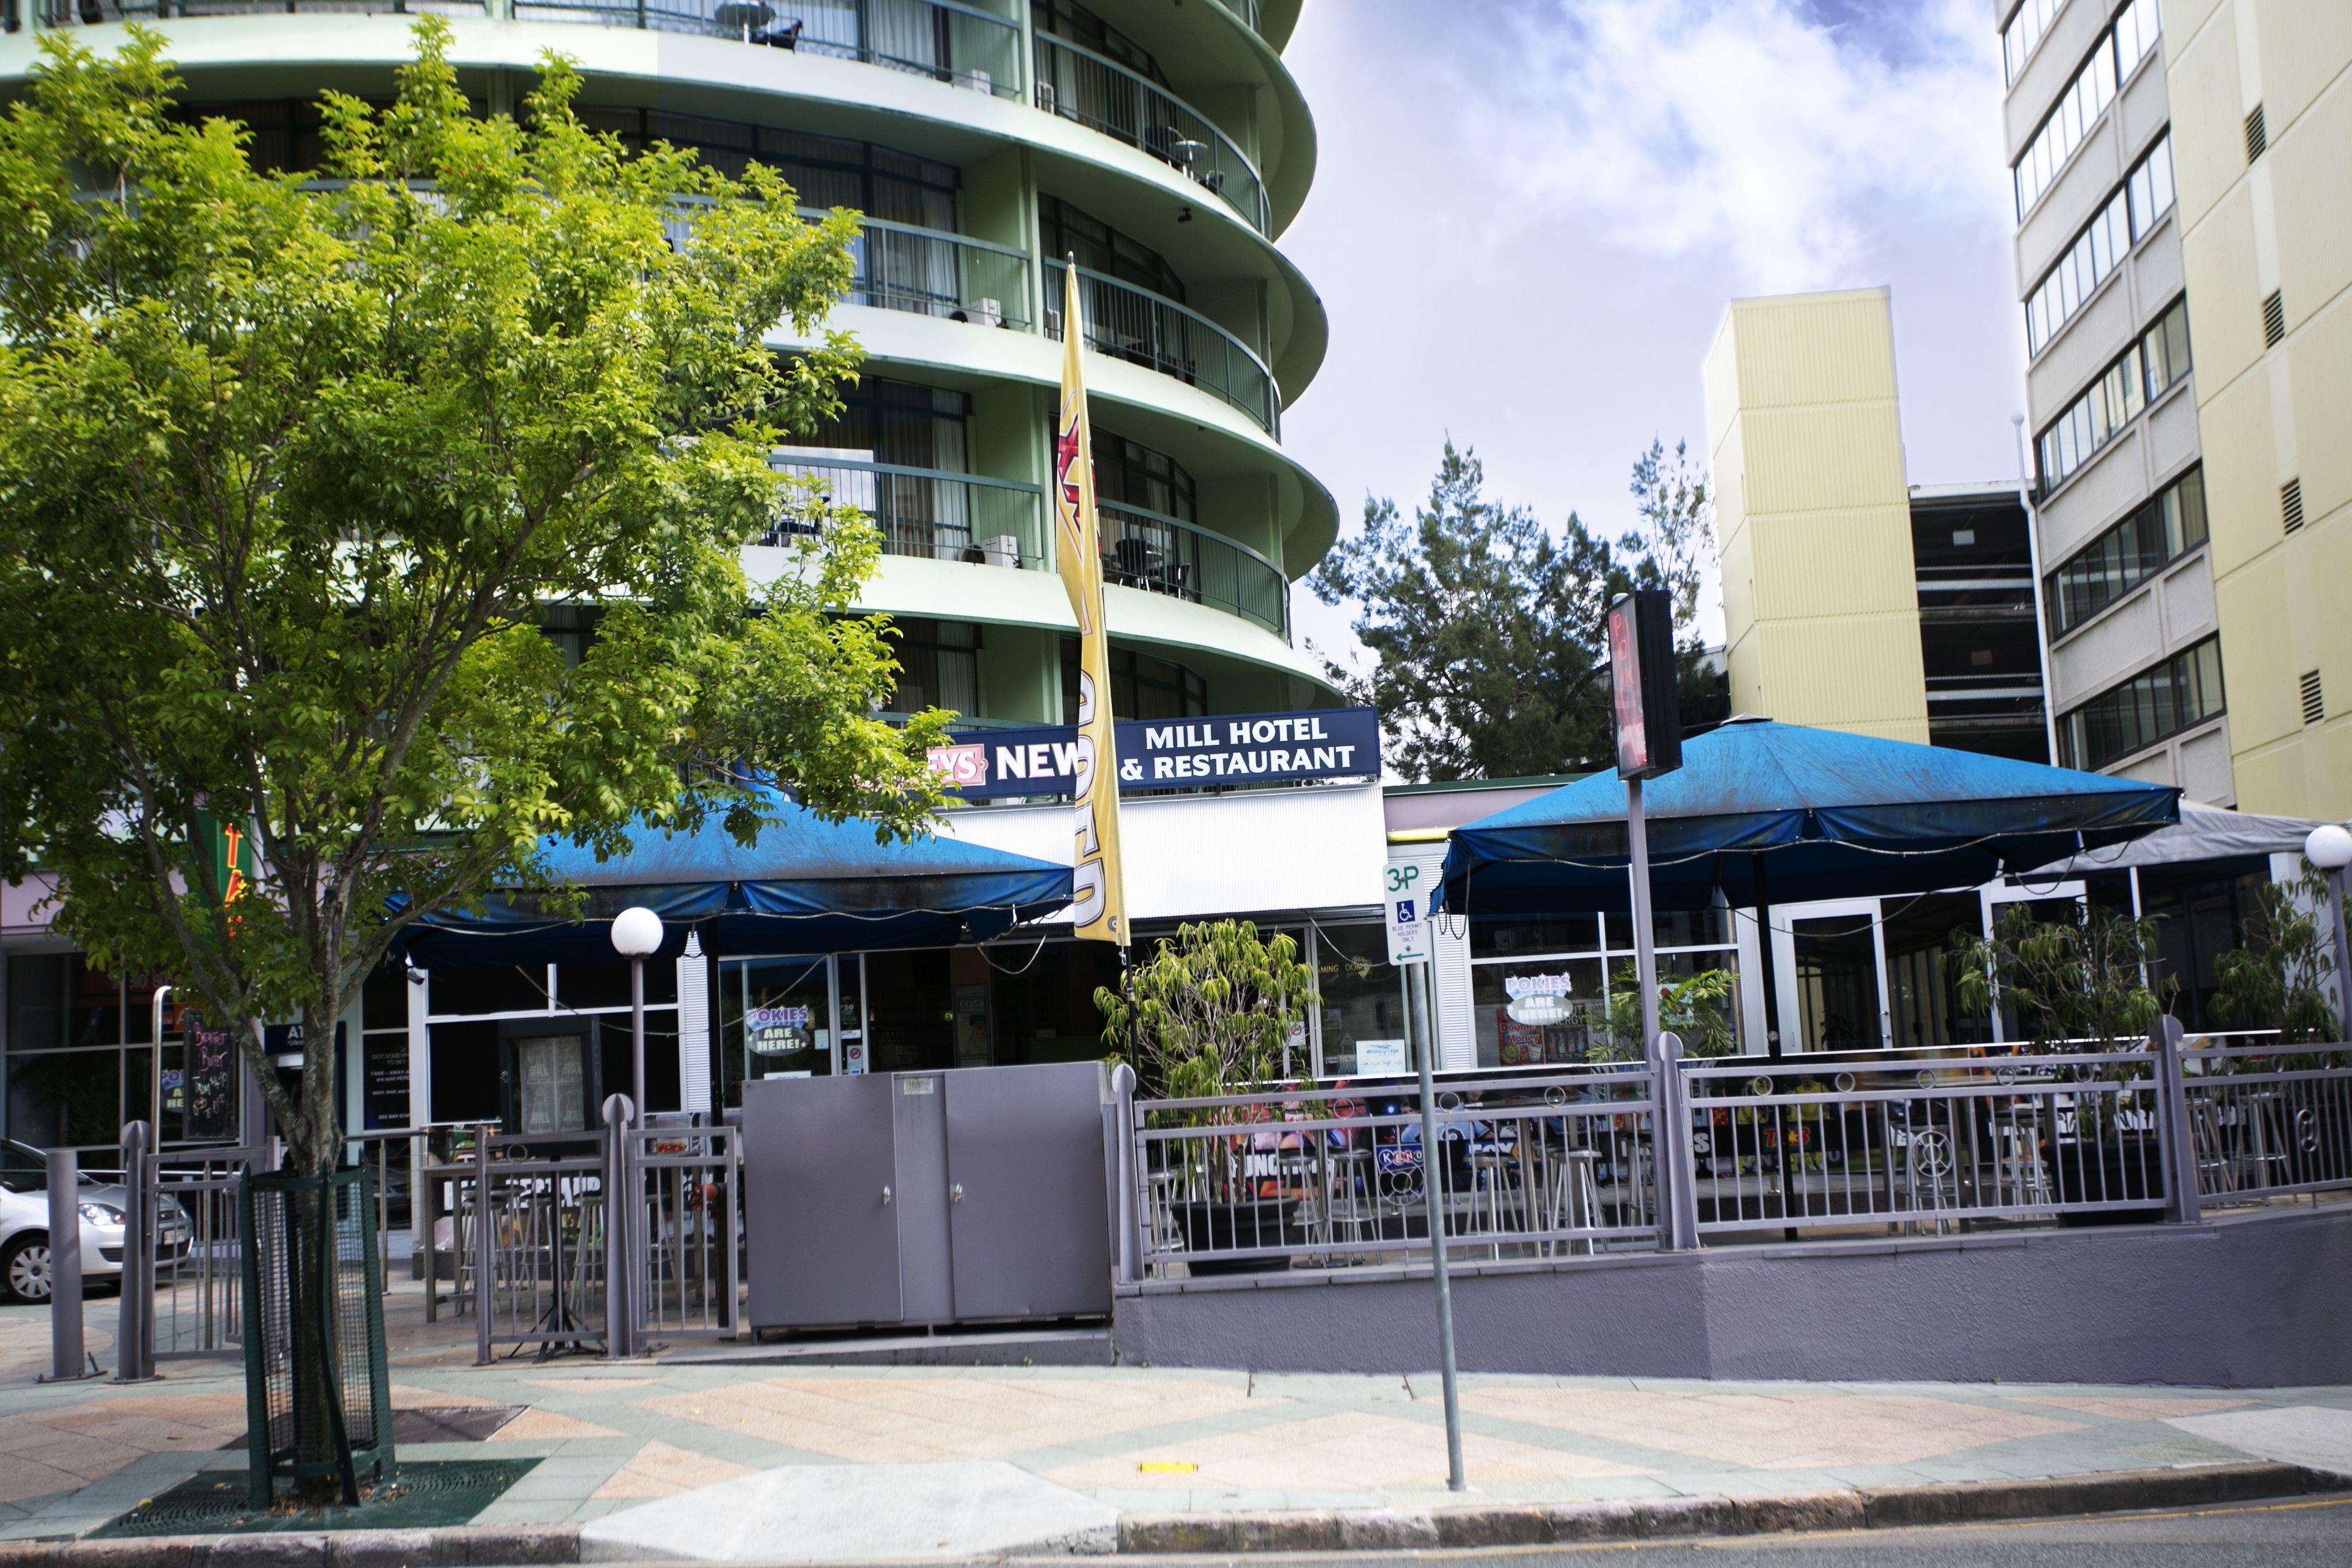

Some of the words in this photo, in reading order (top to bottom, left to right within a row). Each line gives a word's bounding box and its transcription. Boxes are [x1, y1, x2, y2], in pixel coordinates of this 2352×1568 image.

[1145, 724, 1219, 750] MILL
[1229, 717, 1327, 744] HOTEL
[1120, 758, 1144, 781] &
[1154, 745, 1355, 779] RESTAURANT
[1387, 865, 1419, 892] 3P
[1506, 975, 1570, 992] POKIES
[1525, 996, 1555, 1008] ARE
[747, 1008, 809, 1023] POKIES
[1518, 1008, 1562, 1020] HERE!
[764, 1028, 792, 1039] ARE
[1501, 1023, 1536, 1032] Double
[757, 1039, 799, 1051] HERE!
[1507, 1035, 1539, 1044] Money
[1763, 1126, 1811, 1148] TB
